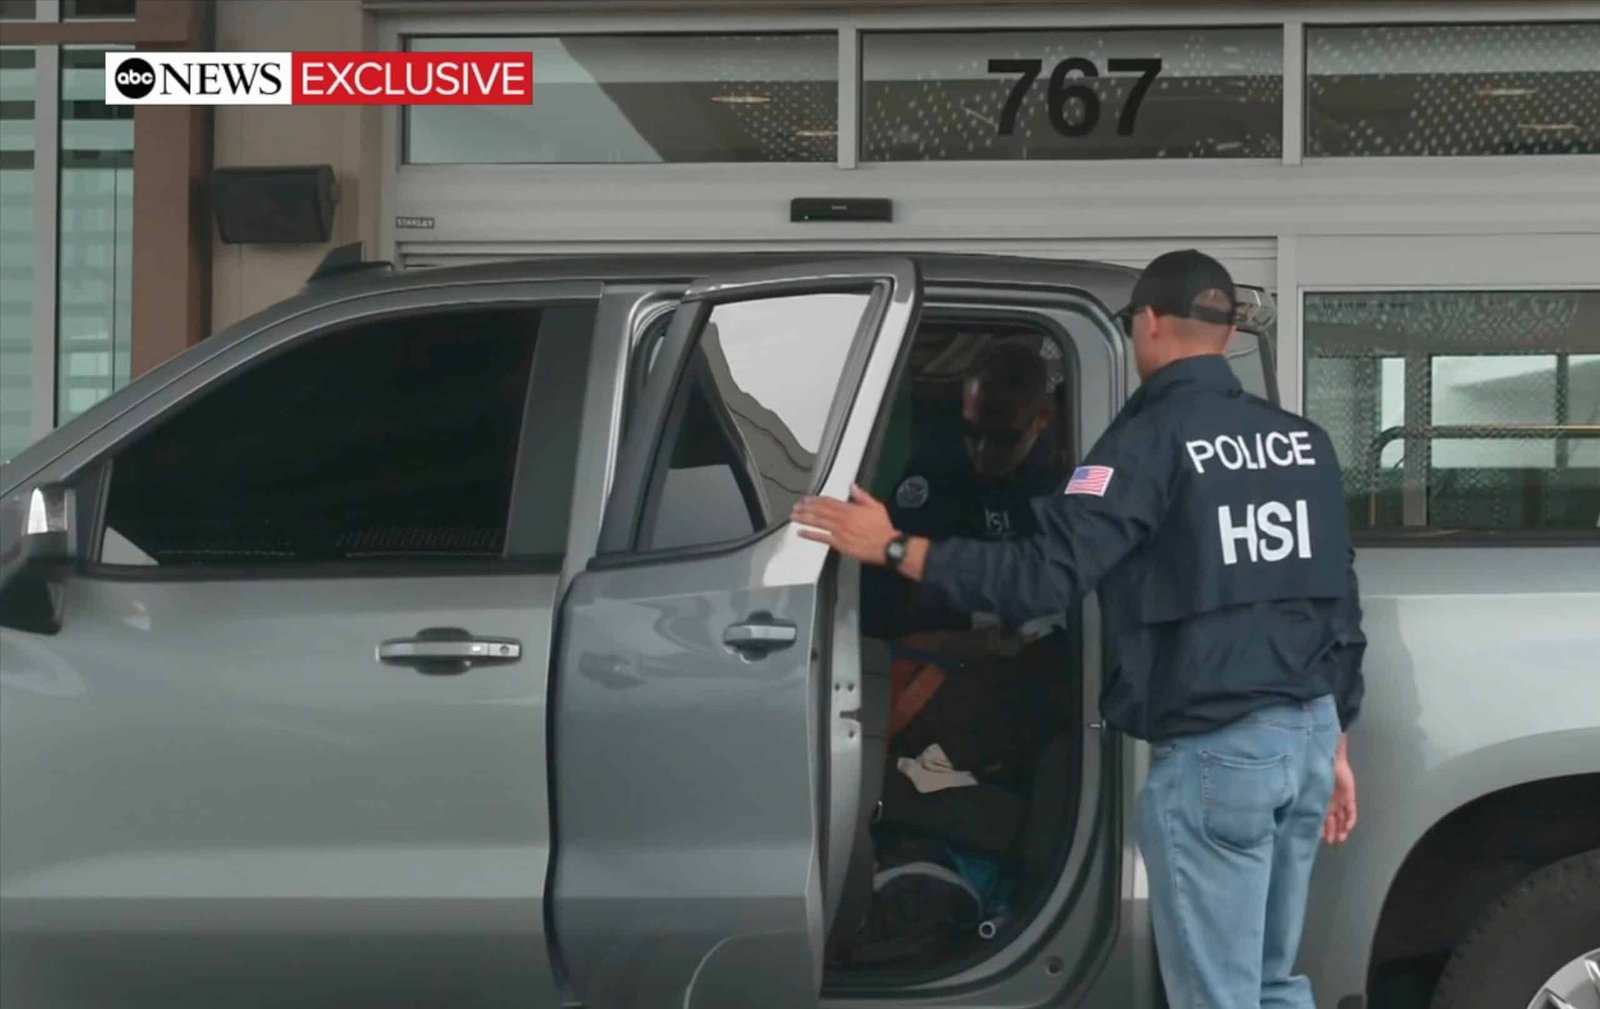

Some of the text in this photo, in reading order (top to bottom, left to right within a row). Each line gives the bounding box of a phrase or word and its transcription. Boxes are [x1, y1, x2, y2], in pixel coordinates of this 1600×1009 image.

[987, 57, 1163, 137] 767
[1186, 431, 1316, 473] POLICE
[1218, 500, 1312, 565] HSI
